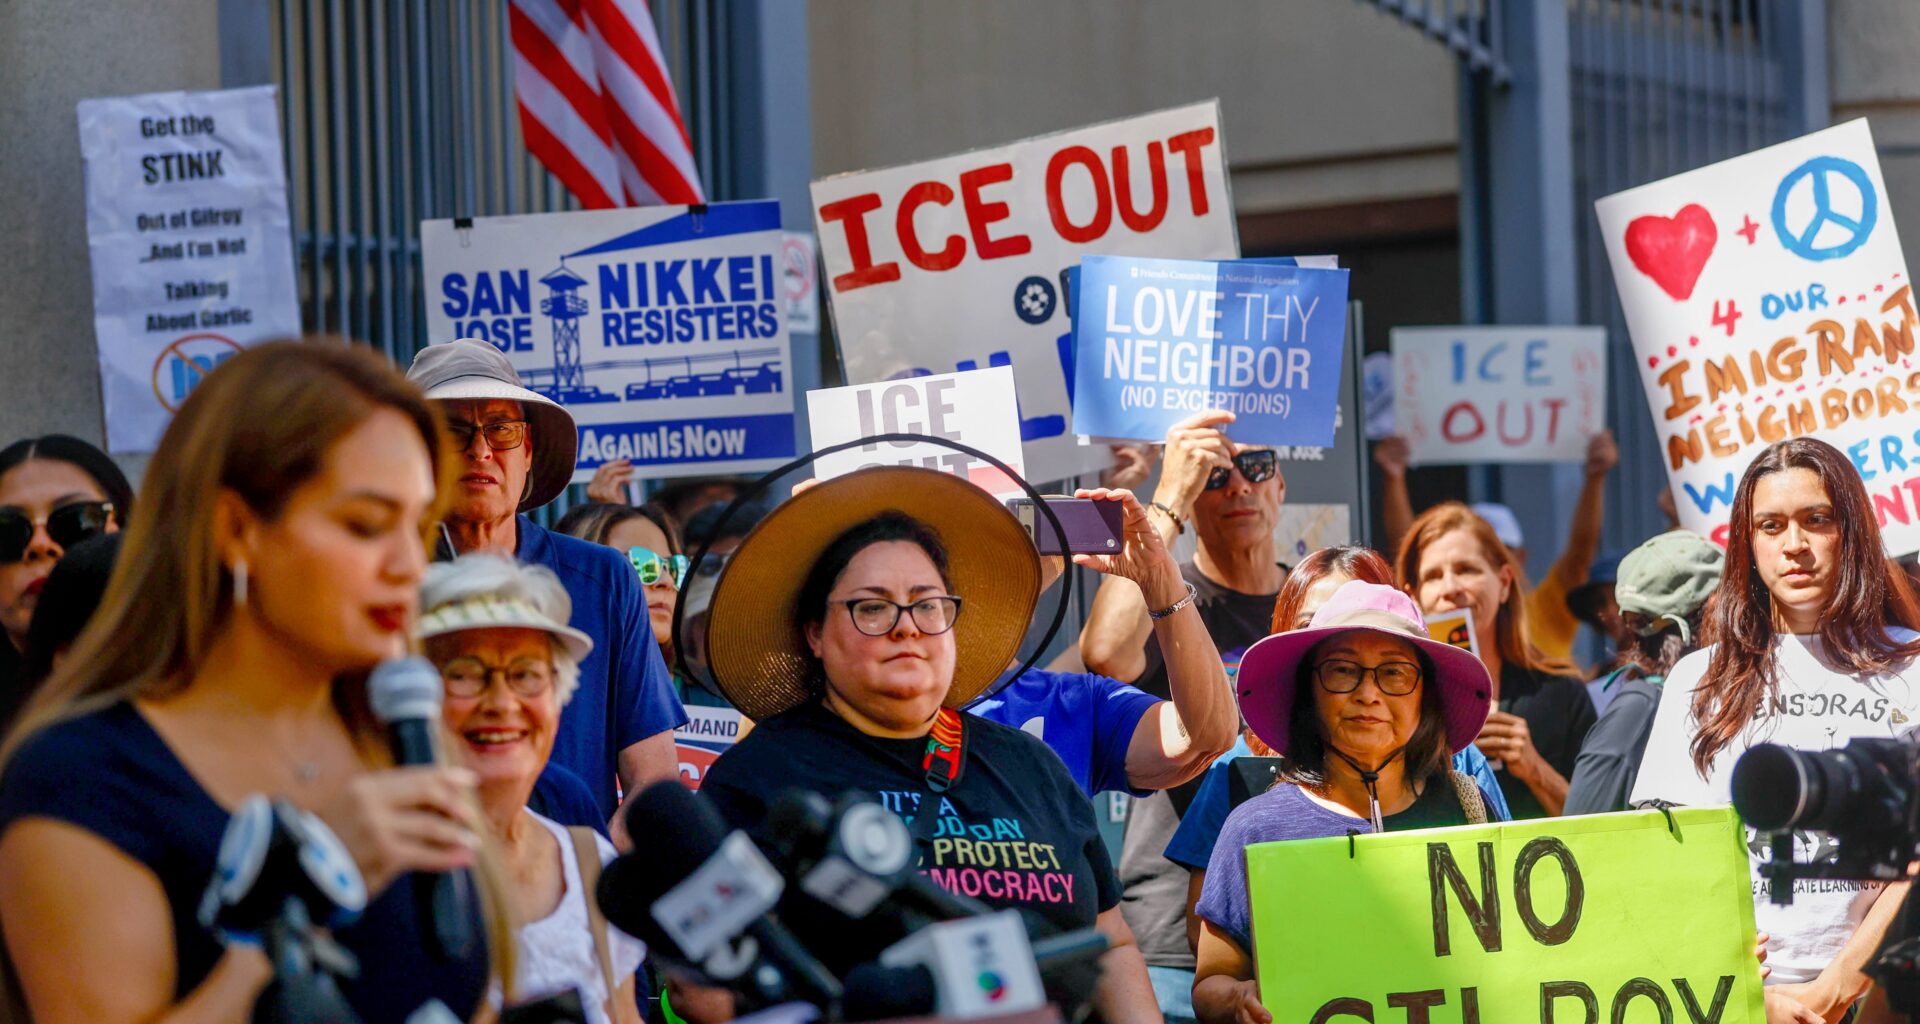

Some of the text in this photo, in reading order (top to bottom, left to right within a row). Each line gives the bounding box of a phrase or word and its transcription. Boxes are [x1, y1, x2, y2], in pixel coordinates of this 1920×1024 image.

[141, 113, 215, 138] Get the
[142, 150, 225, 186] STINK
[137, 208, 242, 231] Out of Gilroy
[819, 126, 1214, 293] ICE OUT
[218, 238, 246, 254] Not
[164, 281, 229, 300] Talking
[442, 255, 774, 319] SAN NIKKEI
[147, 309, 253, 332] About Garlic
[601, 303, 778, 348] RESISTERS
[1106, 284, 1319, 343] LOVE THY
[1104, 337, 1311, 390] NEIGHBOR
[1452, 340, 1552, 386] ICE
[1658, 284, 1919, 421] IMIGRANT
[856, 378, 962, 453] ICE
[1121, 385, 1291, 419] (NO EXCEPTIONS)
[1441, 398, 1568, 447] OUT
[675, 717, 739, 737] MAND
[939, 796, 958, 816] A
[968, 818, 1025, 840] DAY
[933, 837, 1061, 870] PROTECT
[918, 868, 1073, 903] MOCRACY
[1426, 836, 1584, 957] NO
